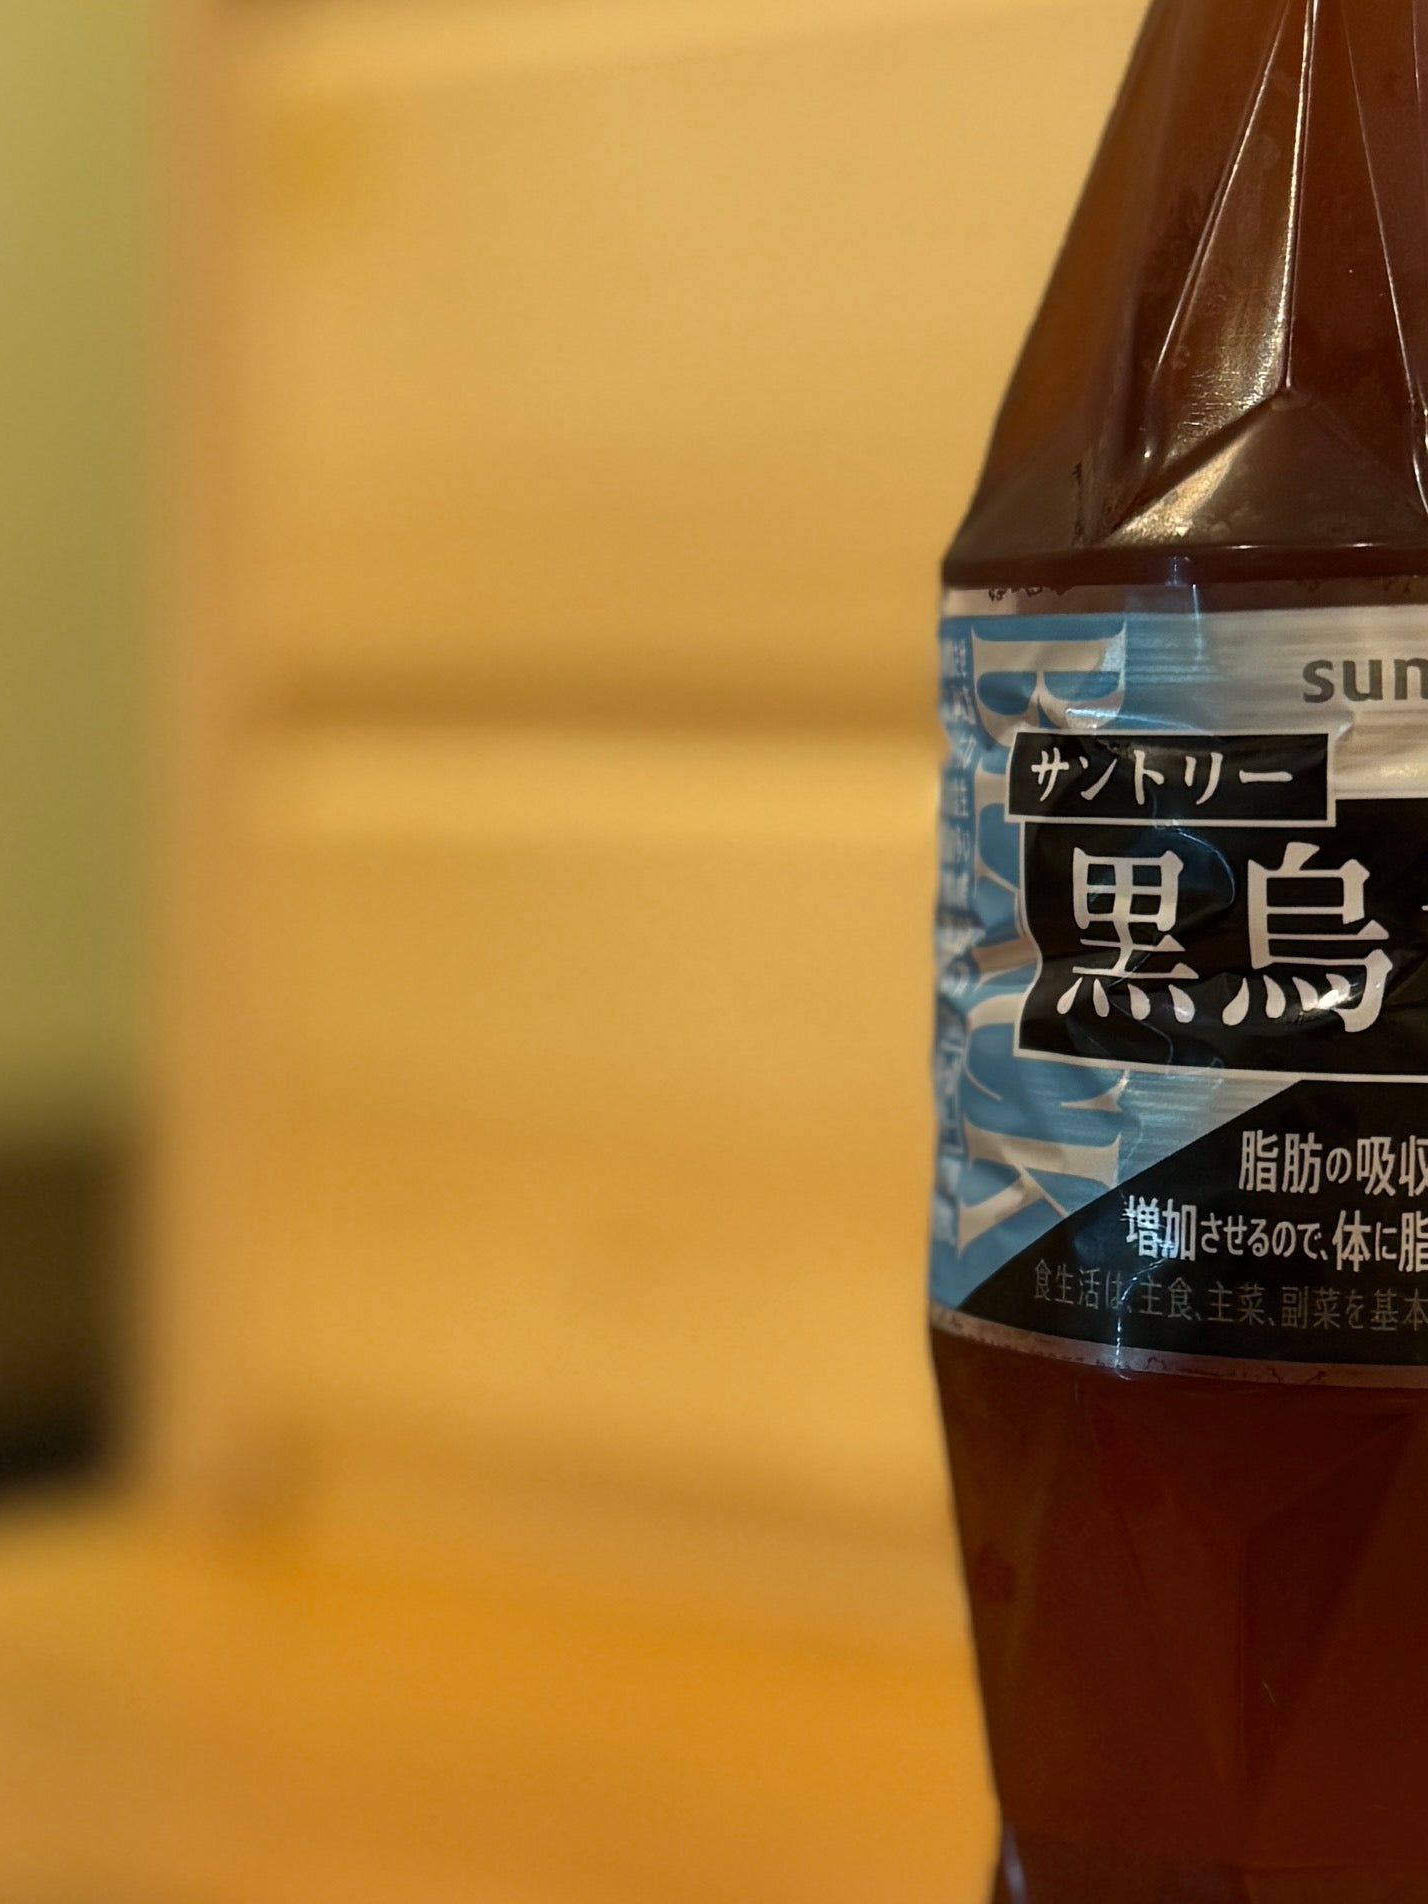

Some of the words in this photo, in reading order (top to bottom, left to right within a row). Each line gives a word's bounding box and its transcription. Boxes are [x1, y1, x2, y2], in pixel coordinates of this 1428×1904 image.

[1029, 749, 1294, 805] サントリー
